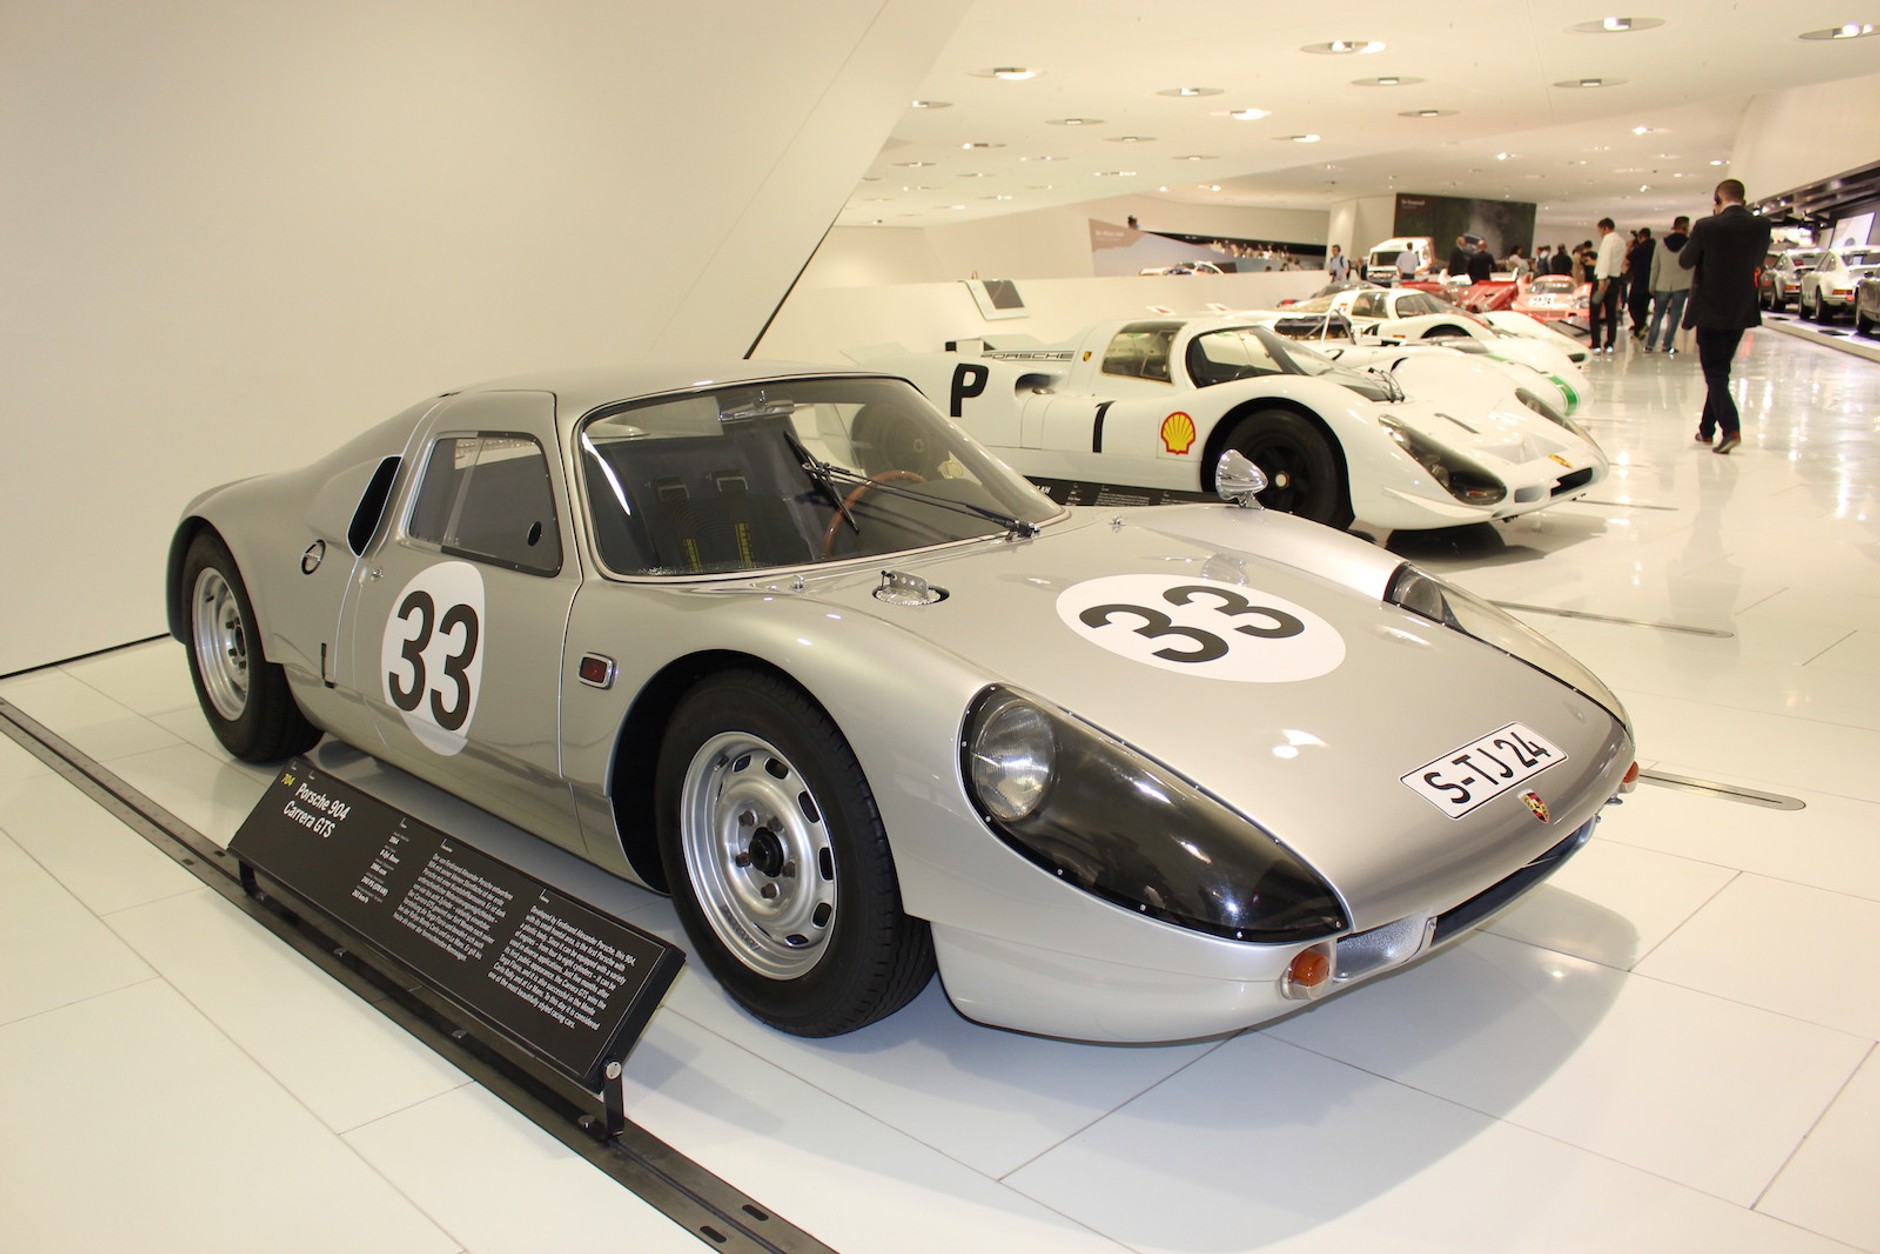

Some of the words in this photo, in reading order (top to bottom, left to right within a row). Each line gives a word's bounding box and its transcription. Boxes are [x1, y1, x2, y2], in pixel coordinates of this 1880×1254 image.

[950, 363, 989, 417] P
[1093, 401, 1117, 453] 1
[1078, 585, 1305, 663] 33
[389, 590, 479, 731] 33
[281, 774, 295, 786] 704
[1424, 748, 1513, 803] S-TJ
[1494, 732, 1551, 768] 24
[283, 800, 316, 829] Carrera
[313, 817, 335, 838] GTS
[295, 783, 330, 810] Porsche
[328, 800, 351, 821] 904
